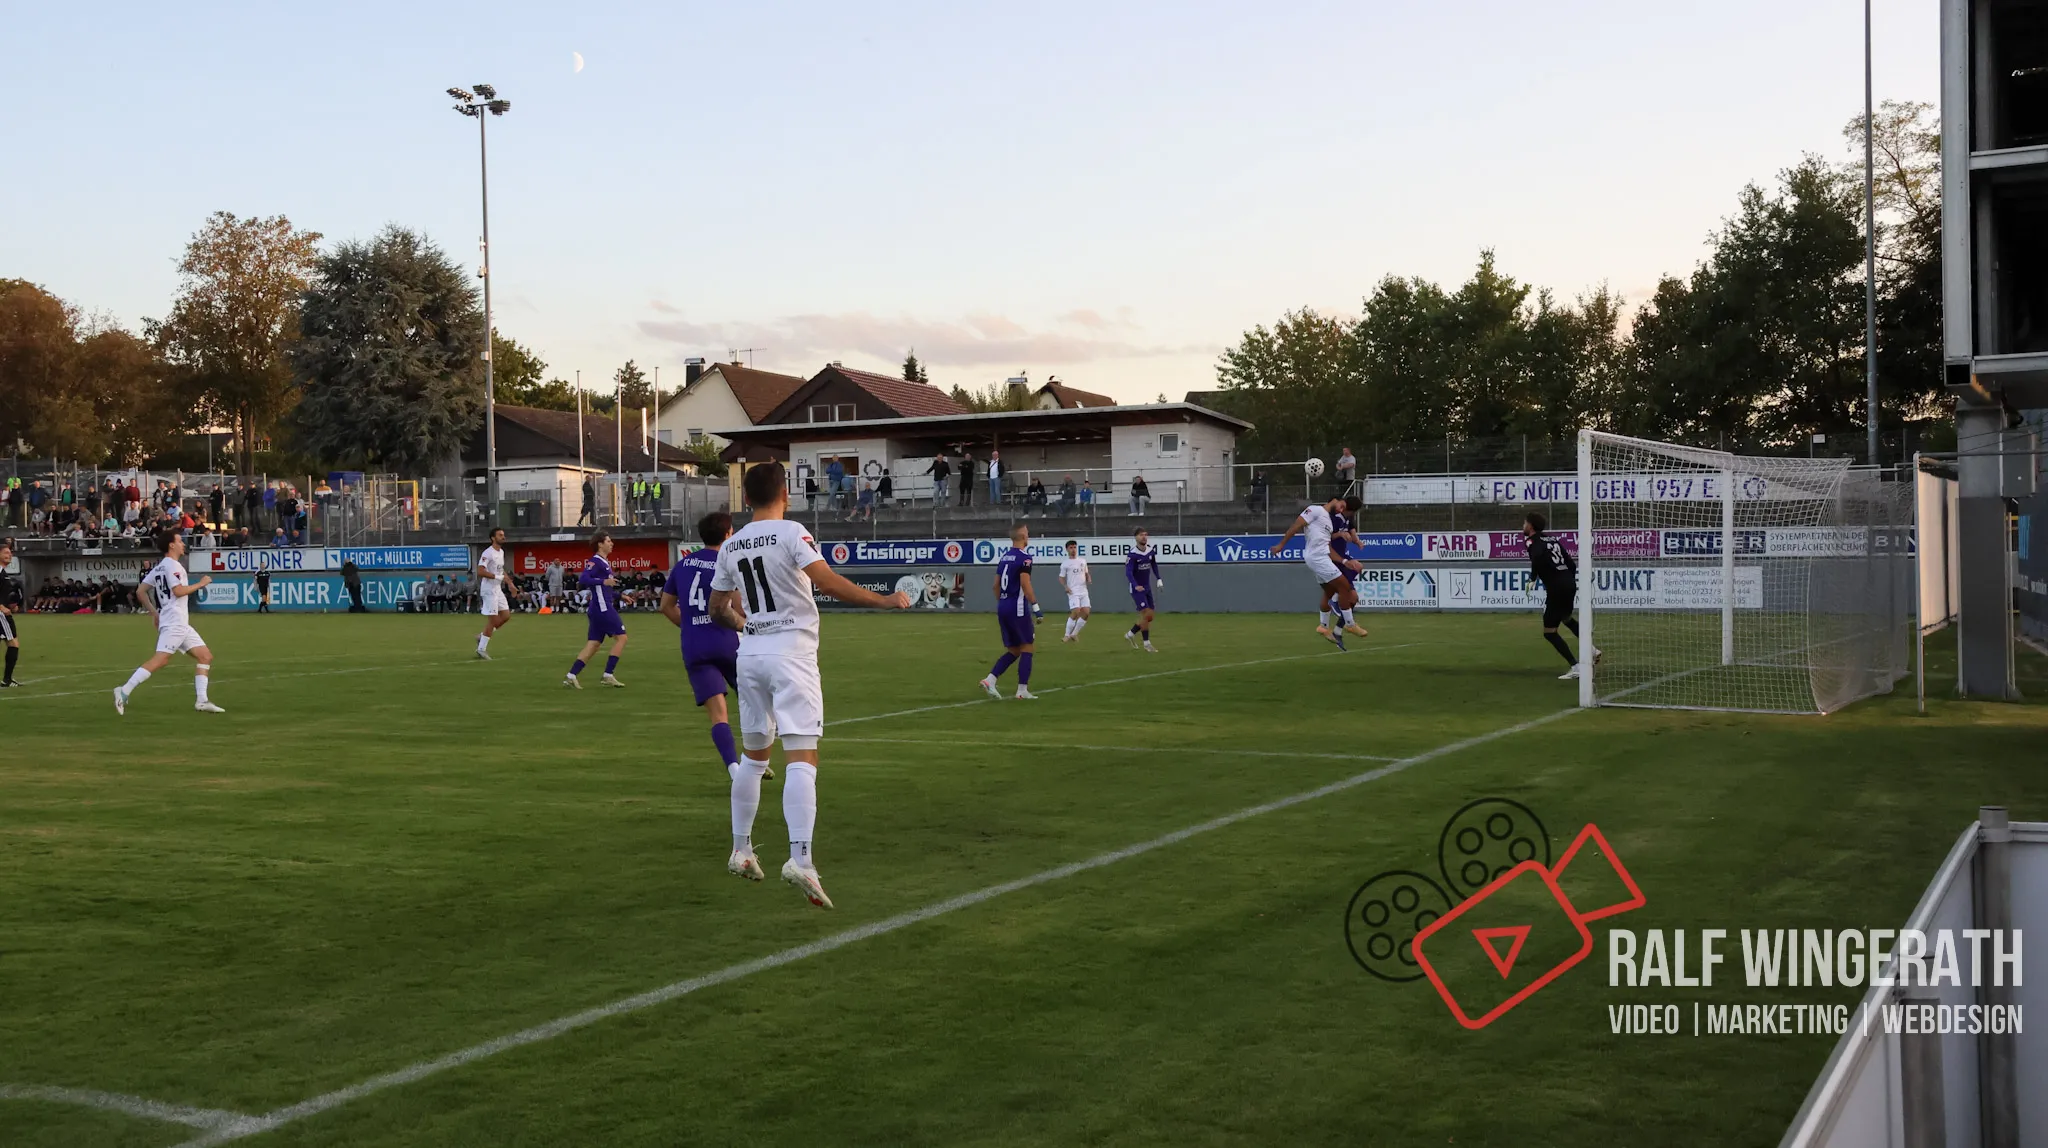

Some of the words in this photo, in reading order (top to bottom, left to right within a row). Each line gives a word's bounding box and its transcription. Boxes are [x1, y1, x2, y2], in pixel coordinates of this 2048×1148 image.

[1493, 481, 1516, 501] FC
[725, 539, 751, 554] YOUNG
[753, 534, 777, 548] BOYS
[855, 543, 938, 563] Ensinger
[1162, 543, 1203, 555] BALL.
[1428, 534, 1478, 552] FARR
[227, 550, 303, 571] GÜLDNER
[630, 557, 651, 568] Calw
[1440, 550, 1485, 558] Wohnwelt
[86, 559, 137, 571] CONSILIA
[737, 556, 777, 614] 11
[1001, 563, 1009, 591] 6
[243, 582, 331, 605] KEINER
[689, 571, 706, 611] 4
[1481, 595, 1508, 605] Praxis
[1511, 595, 1525, 605] für
